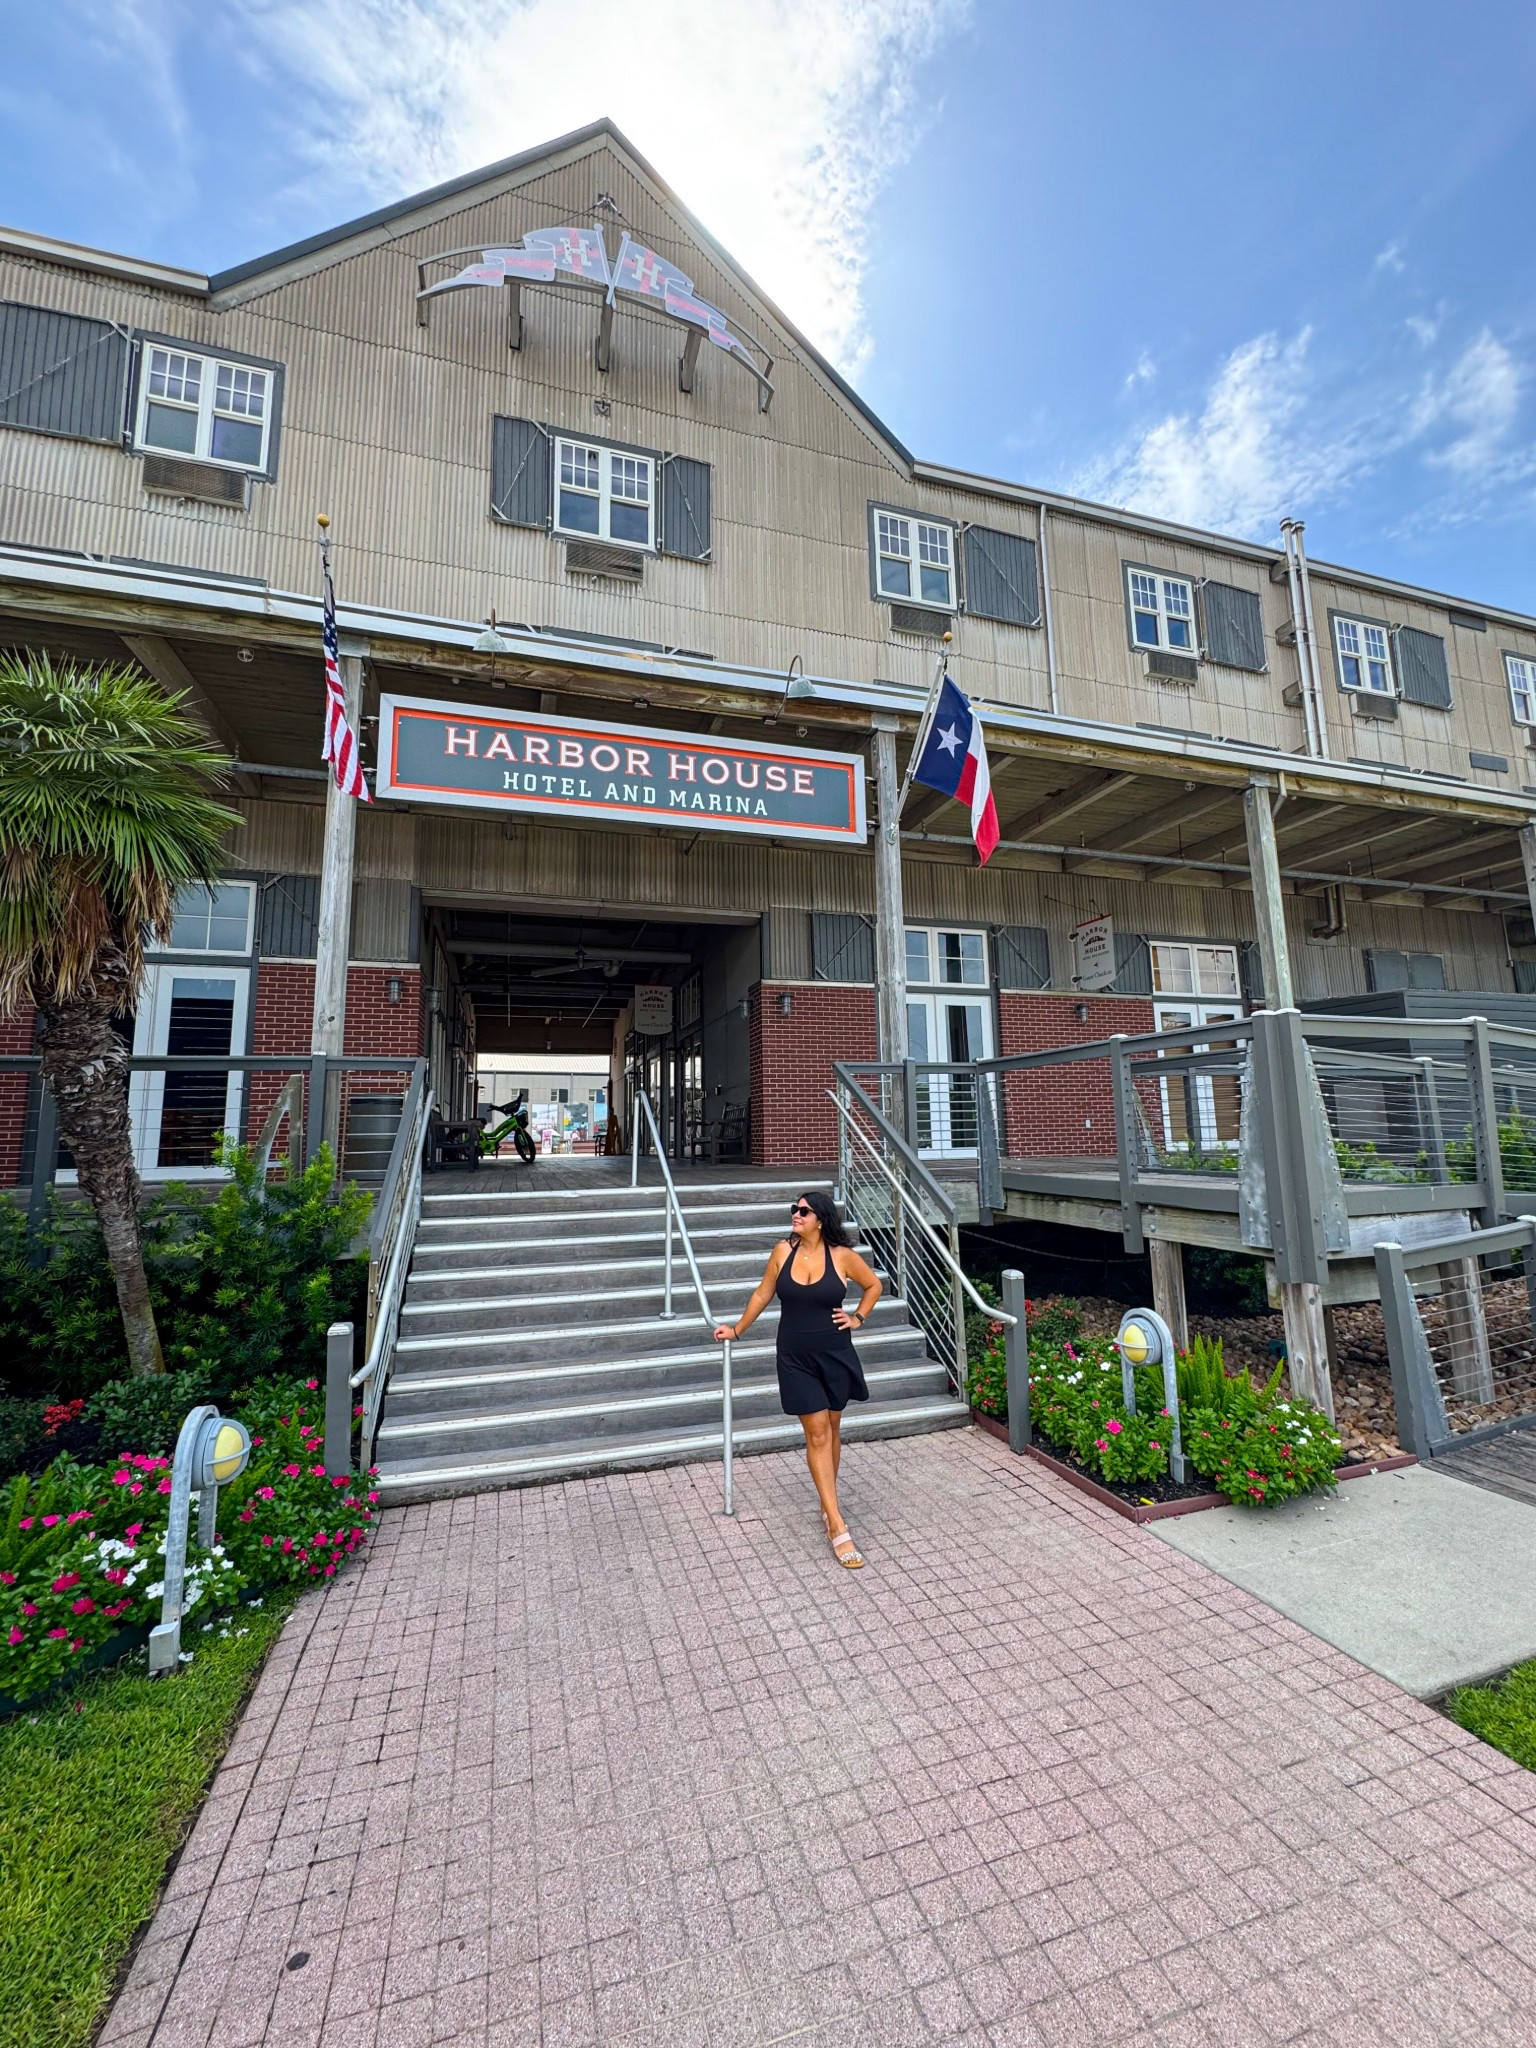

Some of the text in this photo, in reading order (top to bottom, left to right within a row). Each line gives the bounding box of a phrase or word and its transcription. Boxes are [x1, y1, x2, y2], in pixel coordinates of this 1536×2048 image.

[560, 237, 592, 266] H
[631, 253, 663, 291] H
[445, 726, 816, 797] HARBOR HOUSE
[503, 770, 769, 817] HOTEL AND MARINA
[1081, 926, 1108, 942] HARBOR
[1084, 943, 1106, 955] HOUSE
[639, 989, 668, 998] HARBOR
